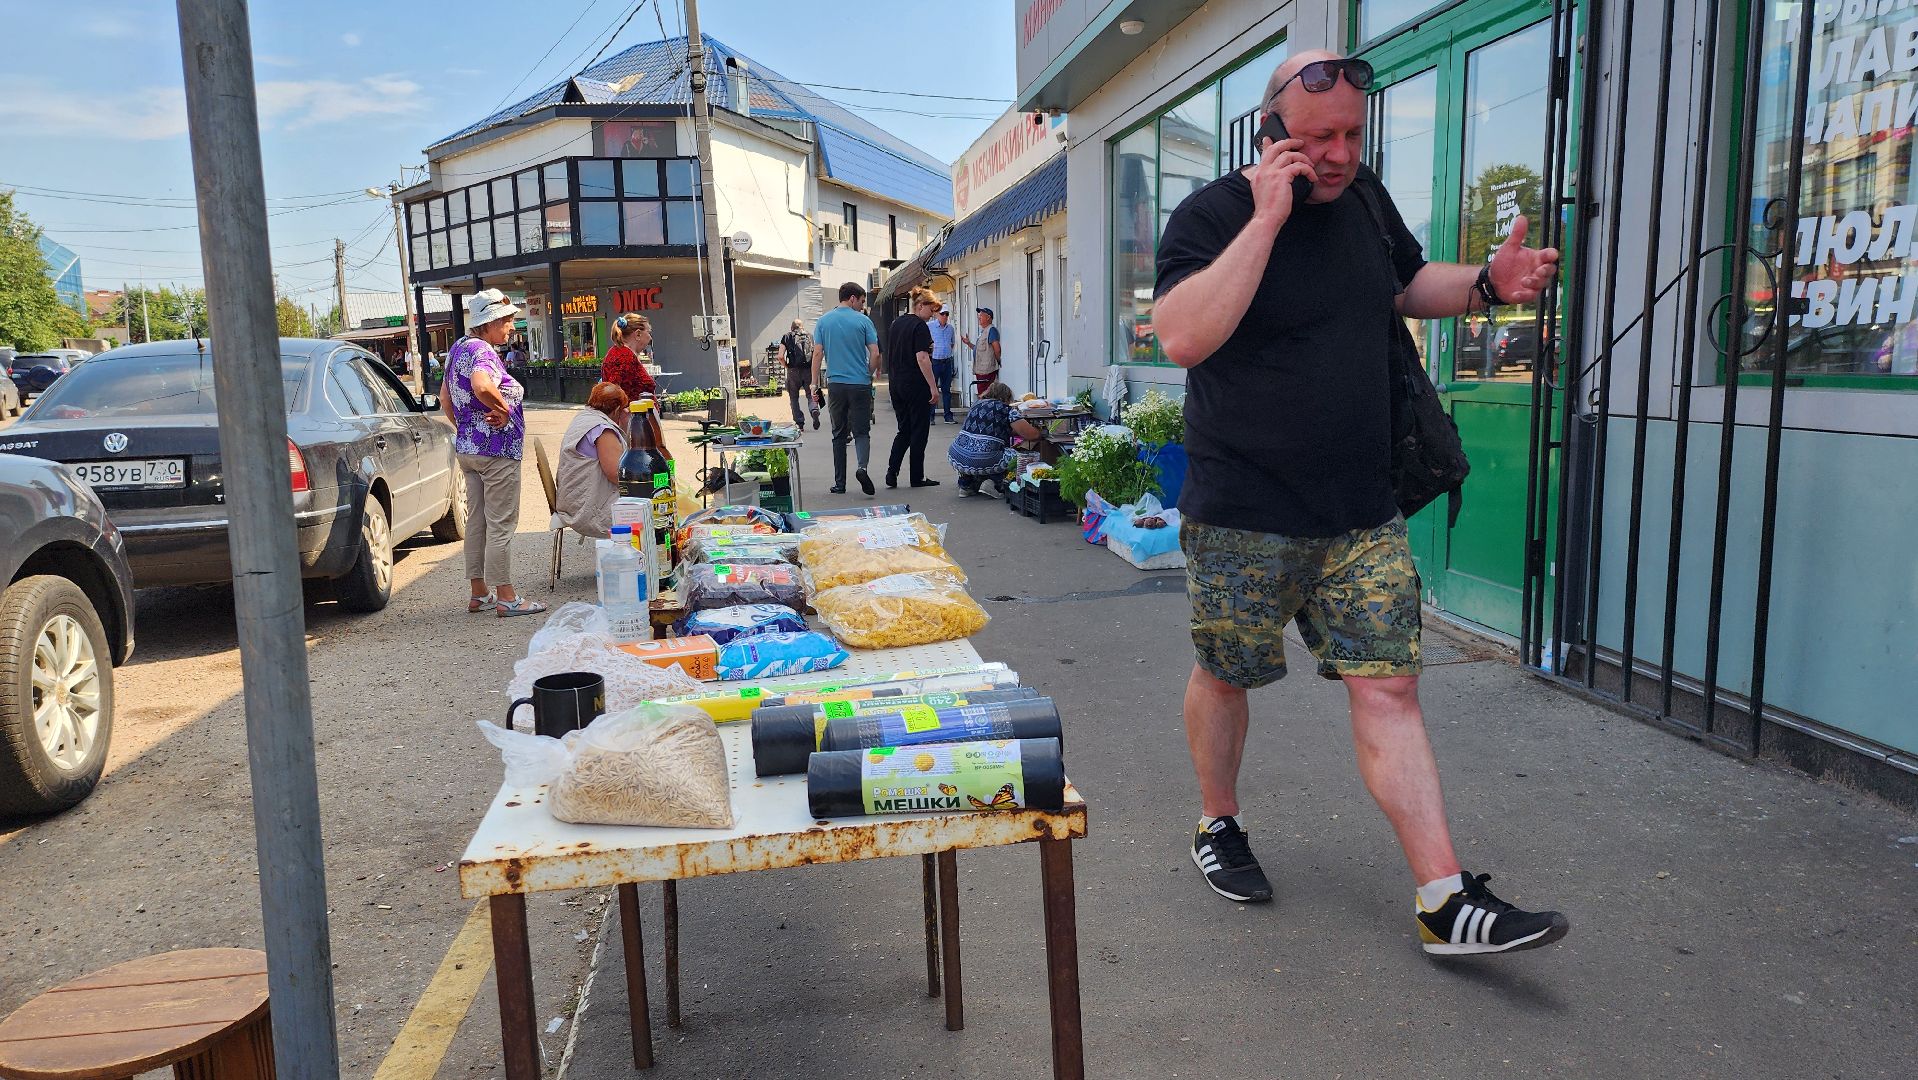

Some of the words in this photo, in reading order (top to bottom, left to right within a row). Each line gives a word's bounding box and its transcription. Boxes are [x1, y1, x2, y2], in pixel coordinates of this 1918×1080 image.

[1776, 204, 1918, 268] ЛЮЛ
[147, 461, 178, 476] 70
[873, 784, 928, 799] Ромашка
[874, 796, 961, 812] МЕШКИ
